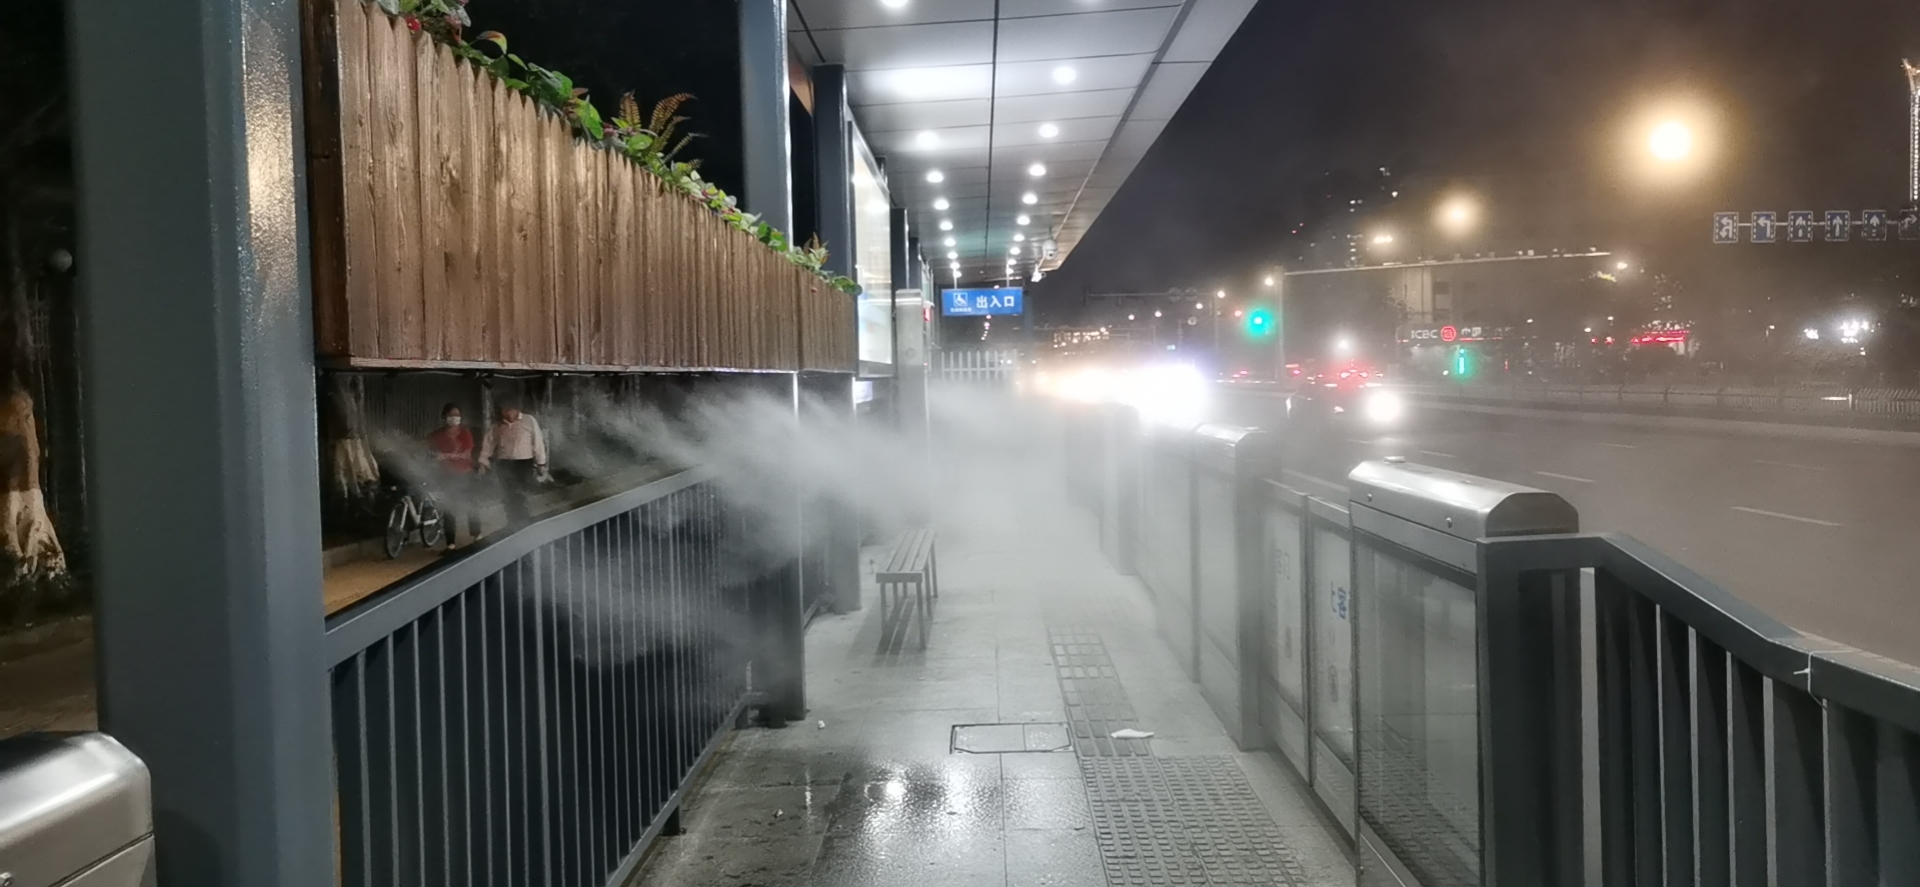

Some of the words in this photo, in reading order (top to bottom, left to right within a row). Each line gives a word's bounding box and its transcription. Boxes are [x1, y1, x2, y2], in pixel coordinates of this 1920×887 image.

[976, 295, 1014, 308] 出入口
[1411, 329, 1438, 339] ICBC
